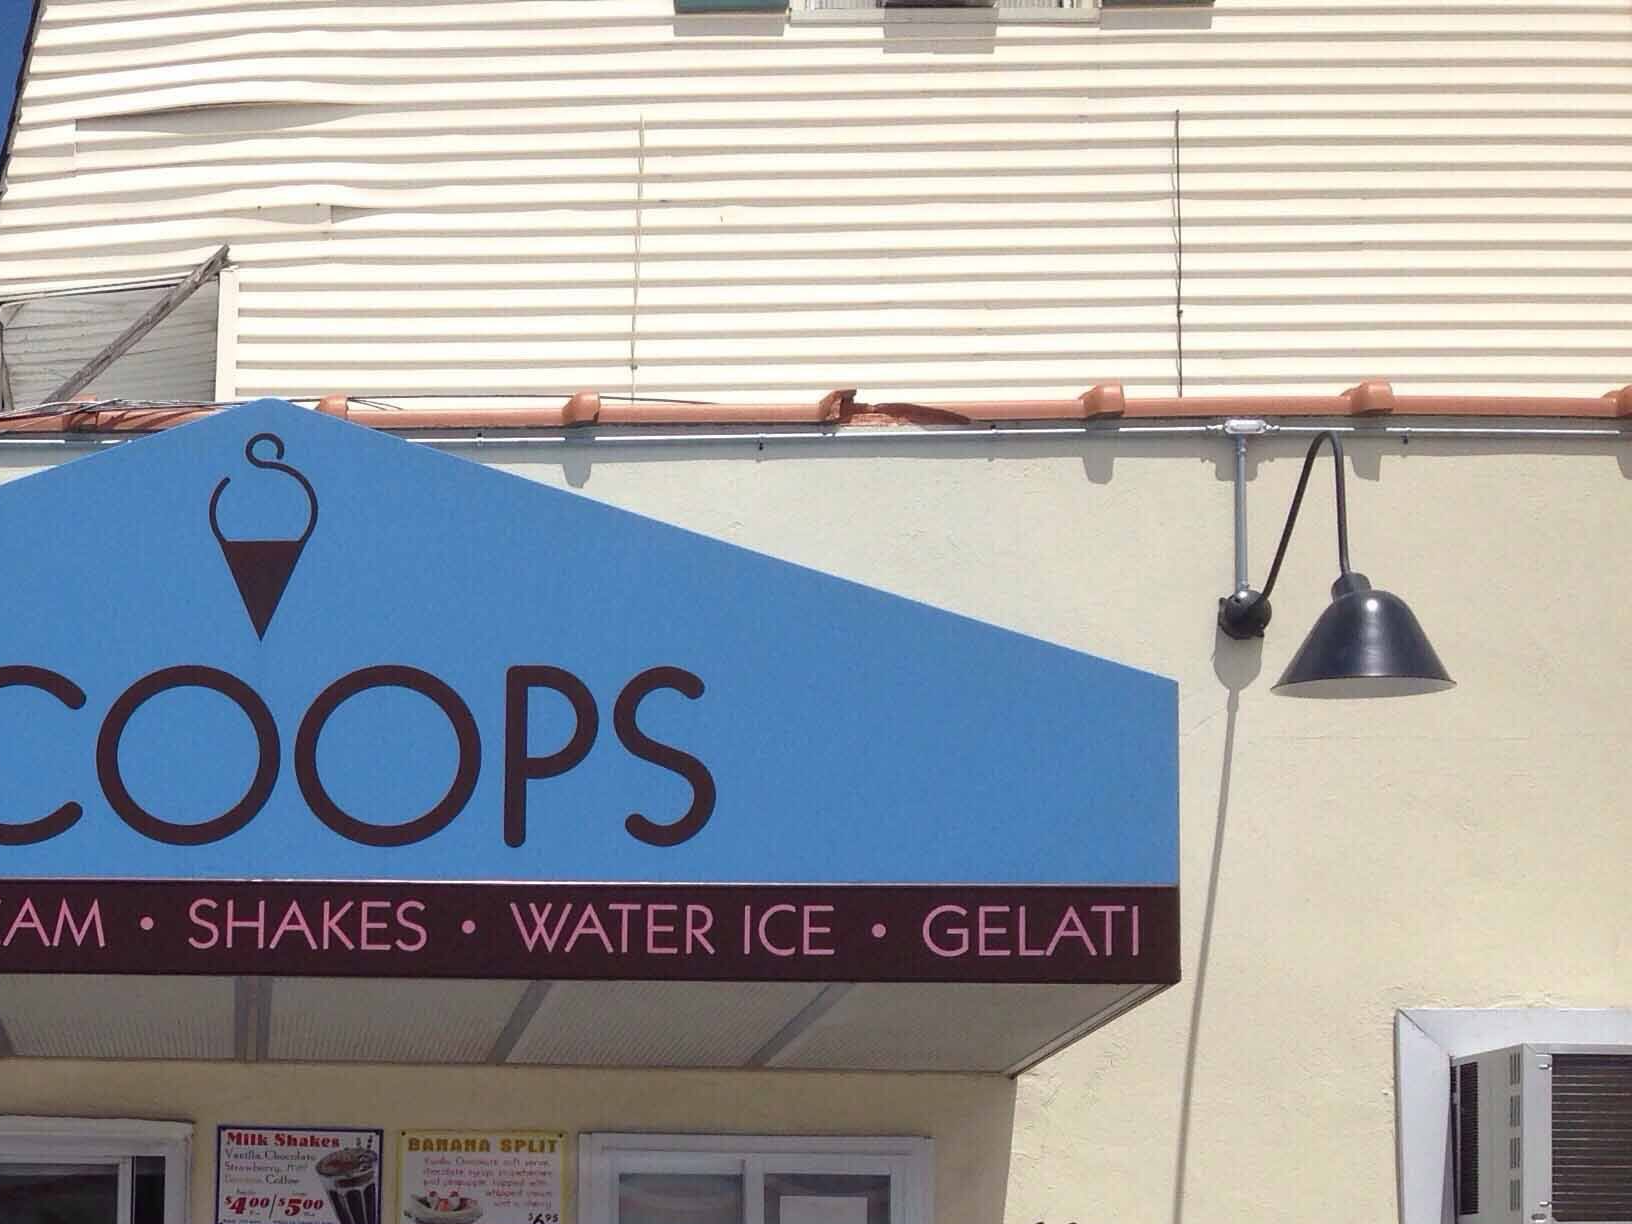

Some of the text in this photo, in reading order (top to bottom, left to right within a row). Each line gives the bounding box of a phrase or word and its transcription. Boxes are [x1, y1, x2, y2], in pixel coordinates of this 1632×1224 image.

[187, 897, 428, 952] SHAKES
[510, 902, 717, 954] WATER
[743, 904, 836, 956] ICE
[920, 904, 1143, 959] GELATI
[226, 1131, 340, 1148] Milk Shakes
[407, 1137, 558, 1154] BANANA SPLIT
